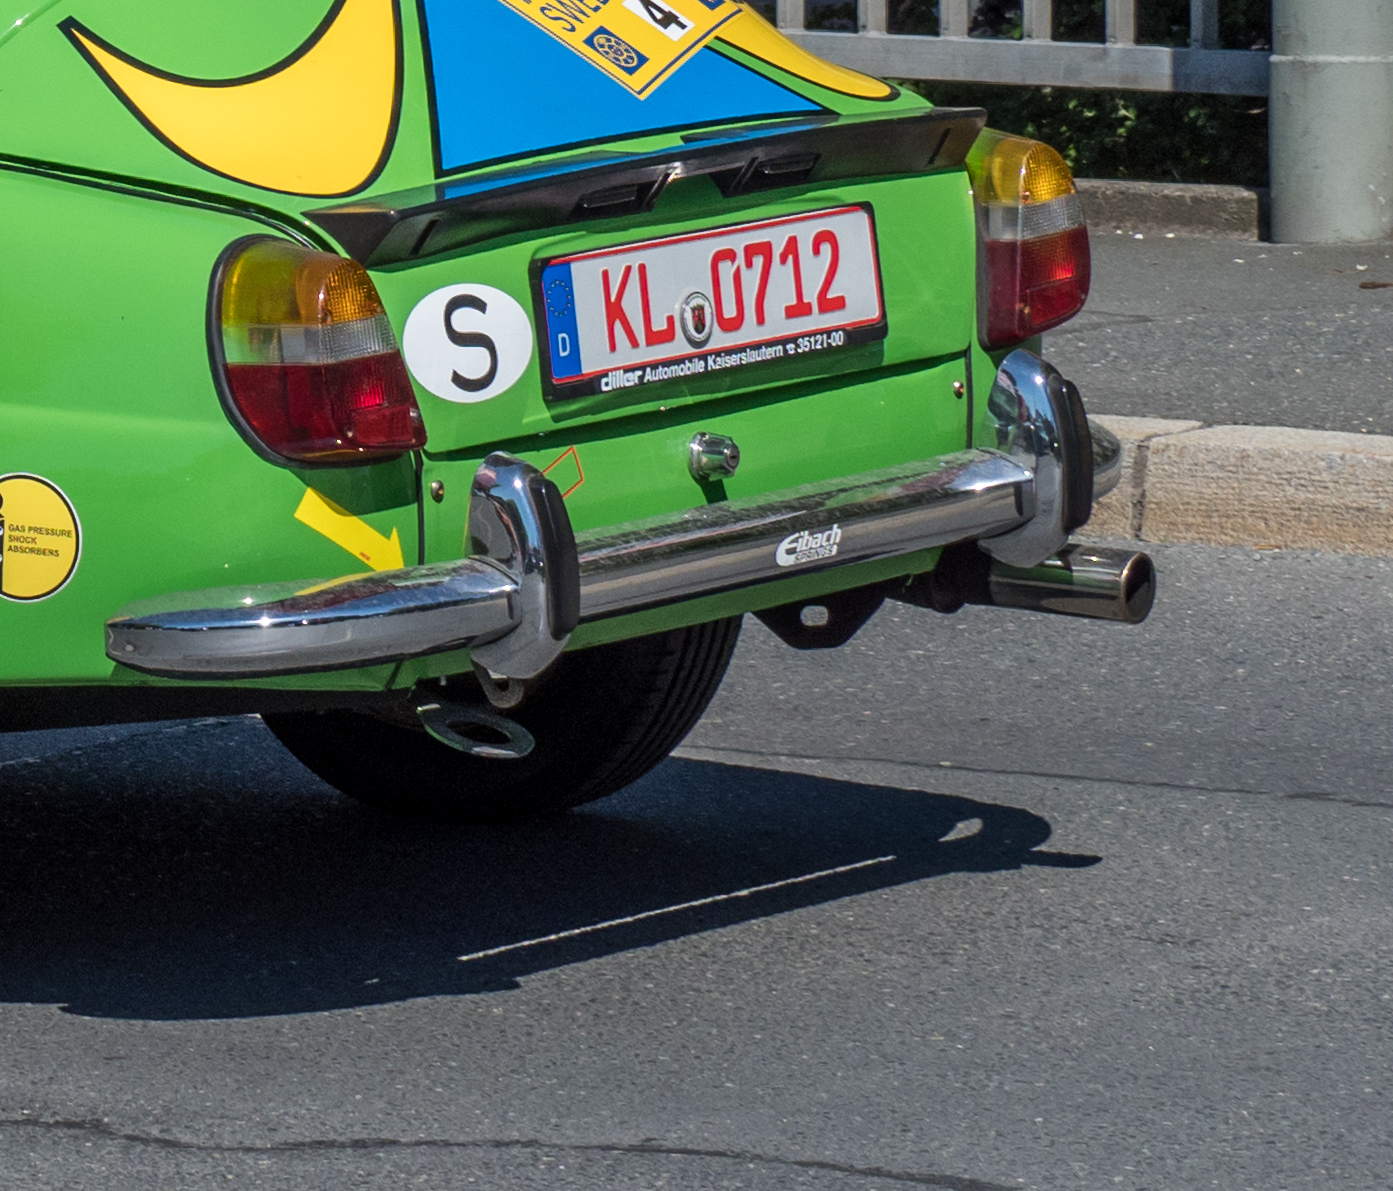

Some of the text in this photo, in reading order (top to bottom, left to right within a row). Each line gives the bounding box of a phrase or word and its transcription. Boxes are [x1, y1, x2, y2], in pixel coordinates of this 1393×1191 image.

[601, 229, 847, 354] KL 0712
[442, 293, 499, 393] S
[557, 331, 571, 358] D
[601, 330, 844, 392] diller Automobile Kaiserslautern 35121-00
[8, 523, 73, 538] GAS PRESSURE
[8, 534, 37, 545] SHOCK
[776, 523, 842, 566] Eibach
[7, 545, 60, 557] ABSORBERS
